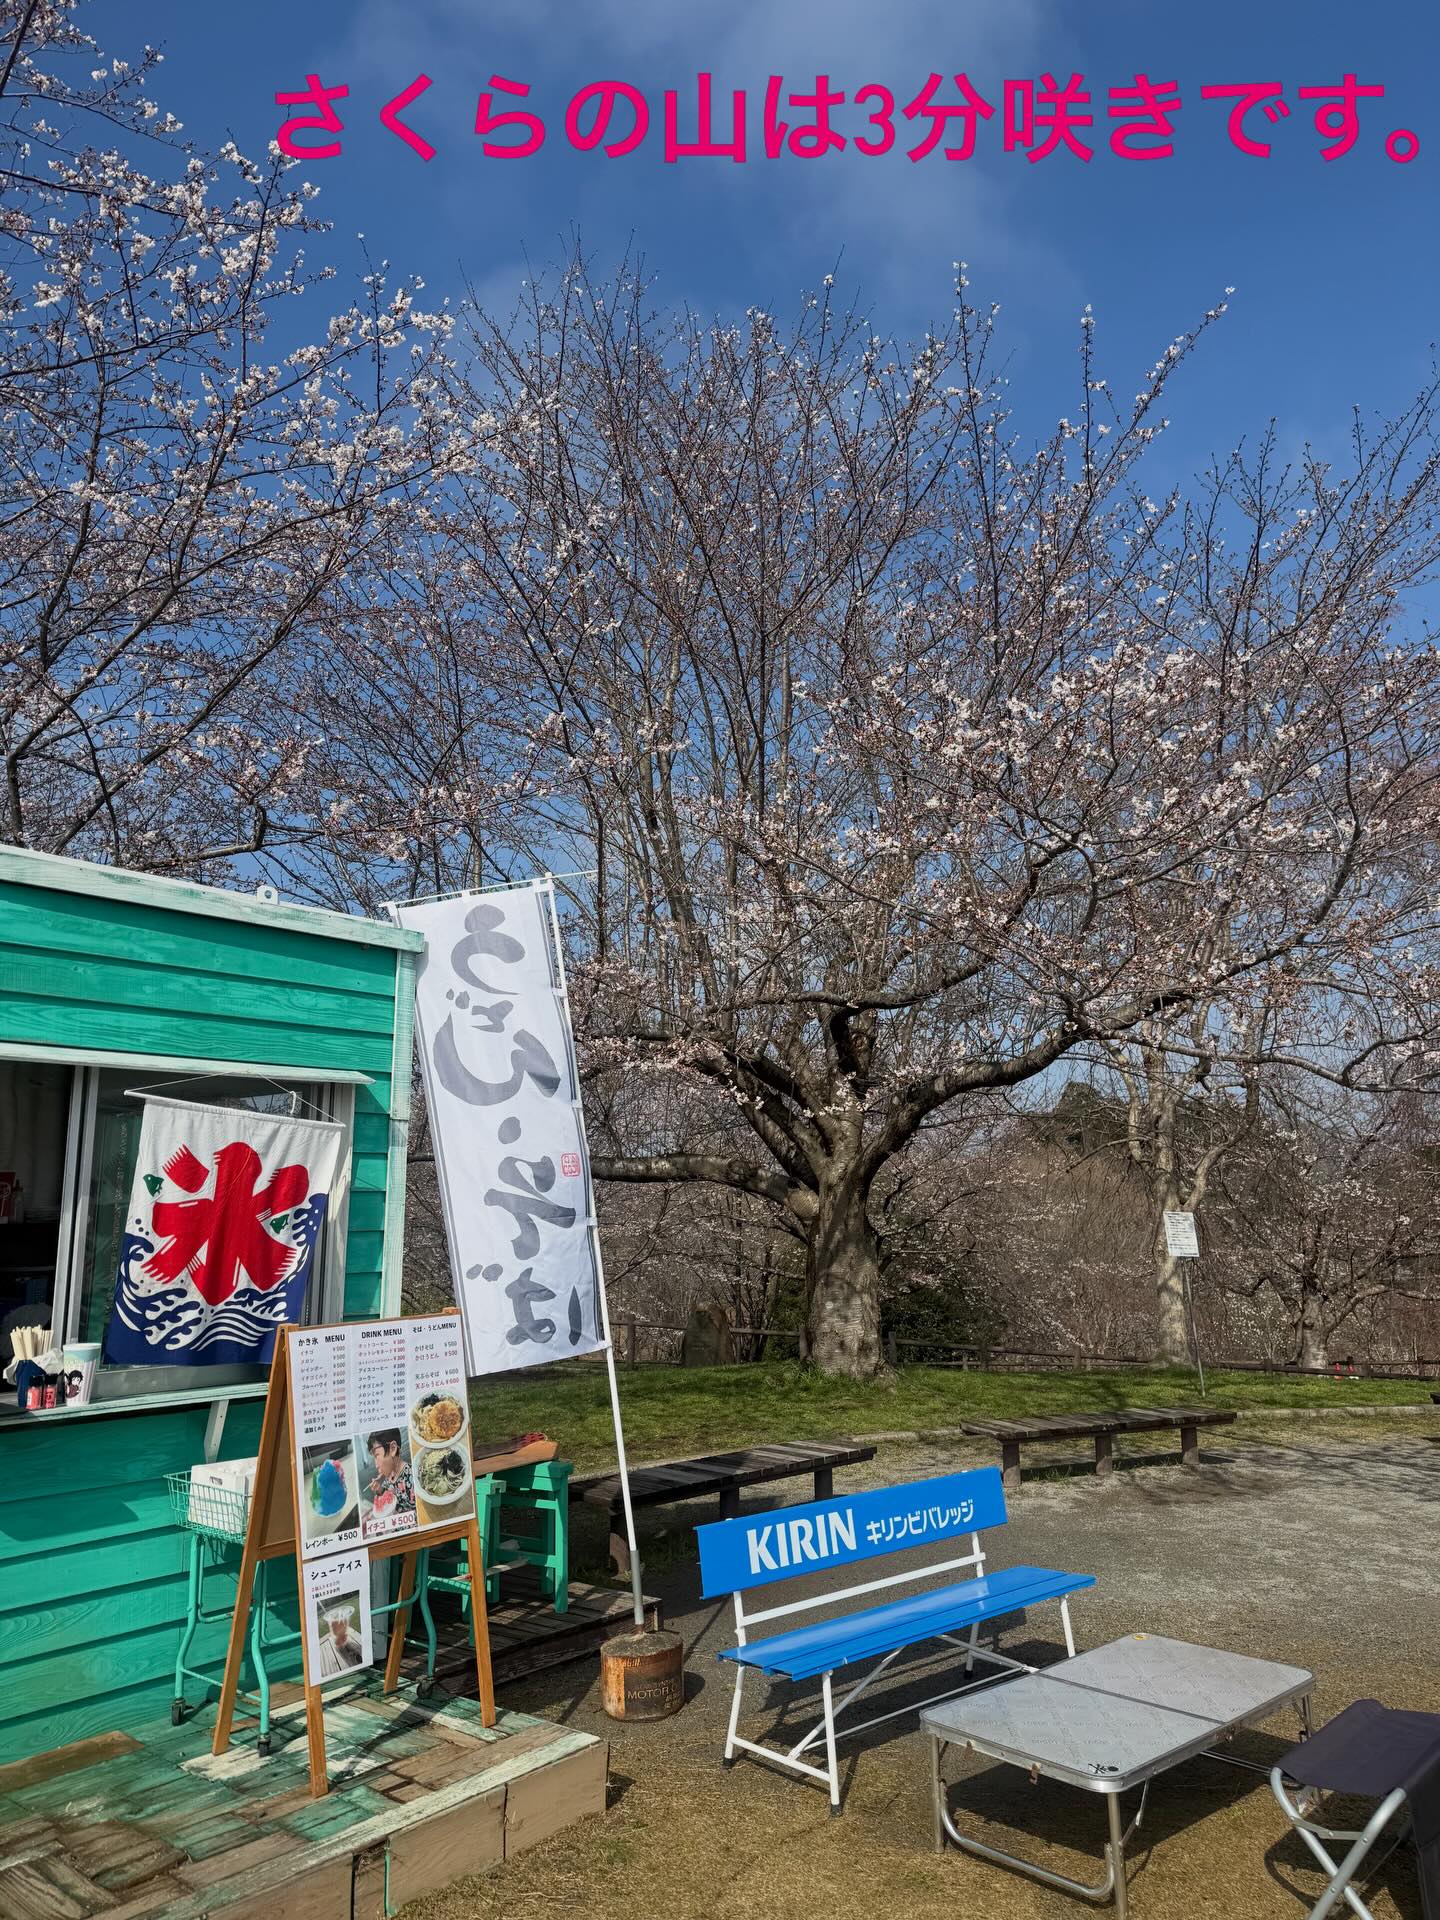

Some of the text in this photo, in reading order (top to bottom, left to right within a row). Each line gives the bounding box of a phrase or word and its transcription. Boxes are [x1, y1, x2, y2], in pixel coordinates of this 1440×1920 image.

[140, 1141, 310, 1307] 氷
[298, 1334, 345, 1347] かき氷 MENU
[361, 1328, 402, 1339] DRINK MENU
[415, 1343, 434, 1353] かけそば
[415, 1351, 440, 1361] かけうどん
[367, 1514, 414, 1532] イチゴ ¥500
[305, 1530, 358, 1550] レインボー ¥500
[746, 1499, 975, 1575] KIRIN キリンビバレッジ
[311, 1560, 362, 1580] シューアイス
[627, 1686, 669, 1700] MOTOR
